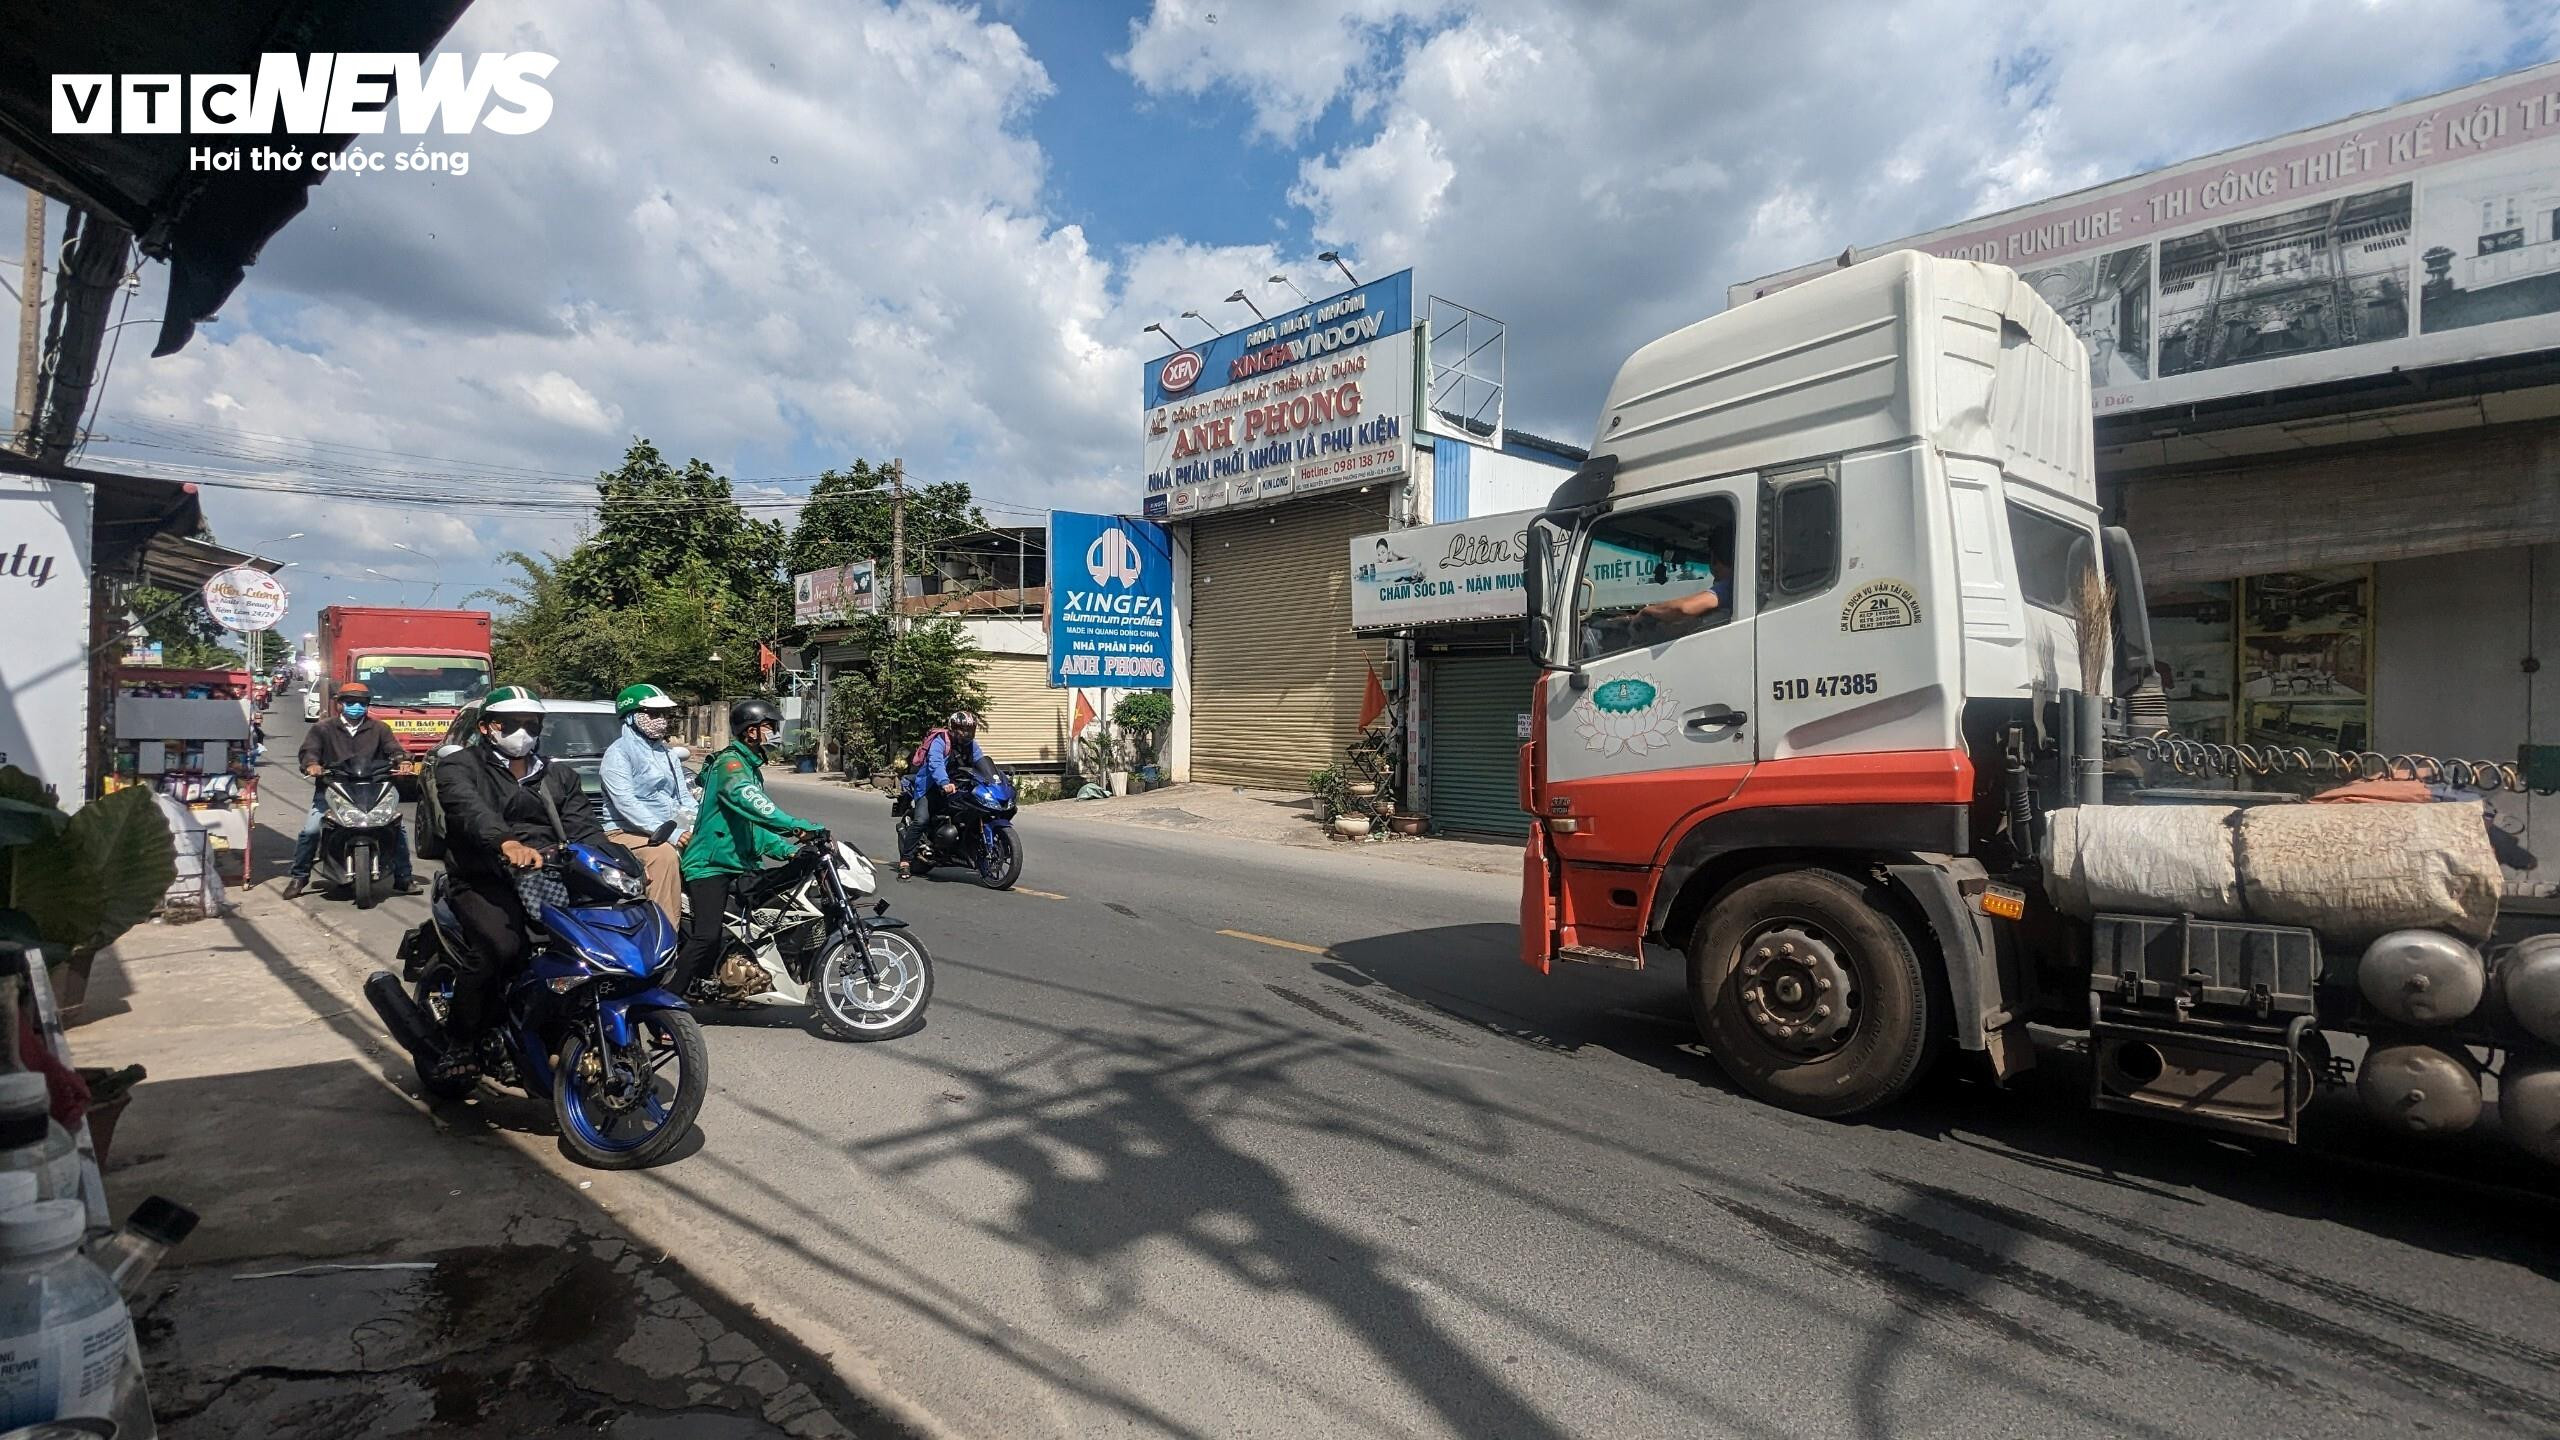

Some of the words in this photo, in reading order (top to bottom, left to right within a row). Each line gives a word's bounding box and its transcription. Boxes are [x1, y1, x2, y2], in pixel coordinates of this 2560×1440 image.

[2007, 208, 2123, 260] FUNITURE
[2149, 190, 2193, 224] THI
[2199, 168, 2278, 211] CÔNG
[2285, 133, 2379, 190] THIẾT
[2388, 112, 2440, 166] KẾ
[2446, 103, 2507, 151] NỘI
[1247, 321, 1276, 347] NHÀ
[1317, 293, 1366, 324] NHÔM
[1168, 359, 1195, 382] XFA
[1171, 404, 1200, 425] CÔNG
[1200, 402, 1212, 416] TY
[1213, 395, 1241, 413] TNHH
[1242, 383, 1270, 405] PHÁT
[1272, 368, 1304, 396] TRIỂN
[1306, 364, 1328, 386] XÂY
[1332, 355, 1367, 379] DỰNG
[2105, 391, 2135, 407] Đức
[1171, 415, 1236, 461] ANH
[1243, 381, 1364, 443] PHONG
[1148, 467, 1173, 493] NHÀ
[1175, 460, 1211, 486] PHÂN
[1213, 447, 1246, 479] PHỐI
[1248, 440, 1293, 470] NHÔM
[1296, 430, 1317, 460] VÀ
[1321, 427, 1354, 456] PHỤ
[1358, 415, 1400, 446] KIỆN
[1333, 458, 1356, 474] 0981
[1359, 454, 1373, 469] 138
[1377, 449, 1395, 465] 779
[1439, 532, 1511, 570] Liên
[1513, 528, 1571, 563] SA
[1379, 581, 1411, 602] CHĂM
[1414, 580, 1436, 598] SÓC
[1439, 580, 1455, 596] DA
[1466, 574, 1492, 595] NẶN
[1495, 572, 1526, 592] MỤN
[1593, 559, 1632, 582] TRIỆT
[245, 601, 272, 610] Beauty
[1064, 590, 1163, 616] XINGFA
[1842, 607, 1852, 622] HTX
[1848, 592, 1863, 608] DỊCH
[1862, 587, 1872, 595] VỤ
[1874, 582, 1889, 593] VẬN
[1890, 584, 1902, 595] TẢI
[1901, 591, 1913, 602] GIA
[1909, 600, 1922, 624] KHANG
[1870, 597, 1889, 610] 2N
[1062, 611, 1121, 625] aluminium
[1120, 616, 1163, 627] profiles
[1066, 626, 1086, 635] MADE
[1086, 627, 1094, 636] IN
[1095, 628, 1119, 636] QUANG
[1119, 629, 1139, 638] DONG
[1072, 640, 1096, 651] NHÀ
[1097, 640, 1127, 653] PHÂN
[1129, 642, 1153, 654] PHỐI
[1060, 654, 1099, 675] ANH
[1104, 655, 1165, 678] PHONG
[1773, 679, 1809, 701] 51D
[1815, 672, 1878, 698] 47385
[617, 697, 634, 709] Grab
[741, 784, 776, 815] Grab
